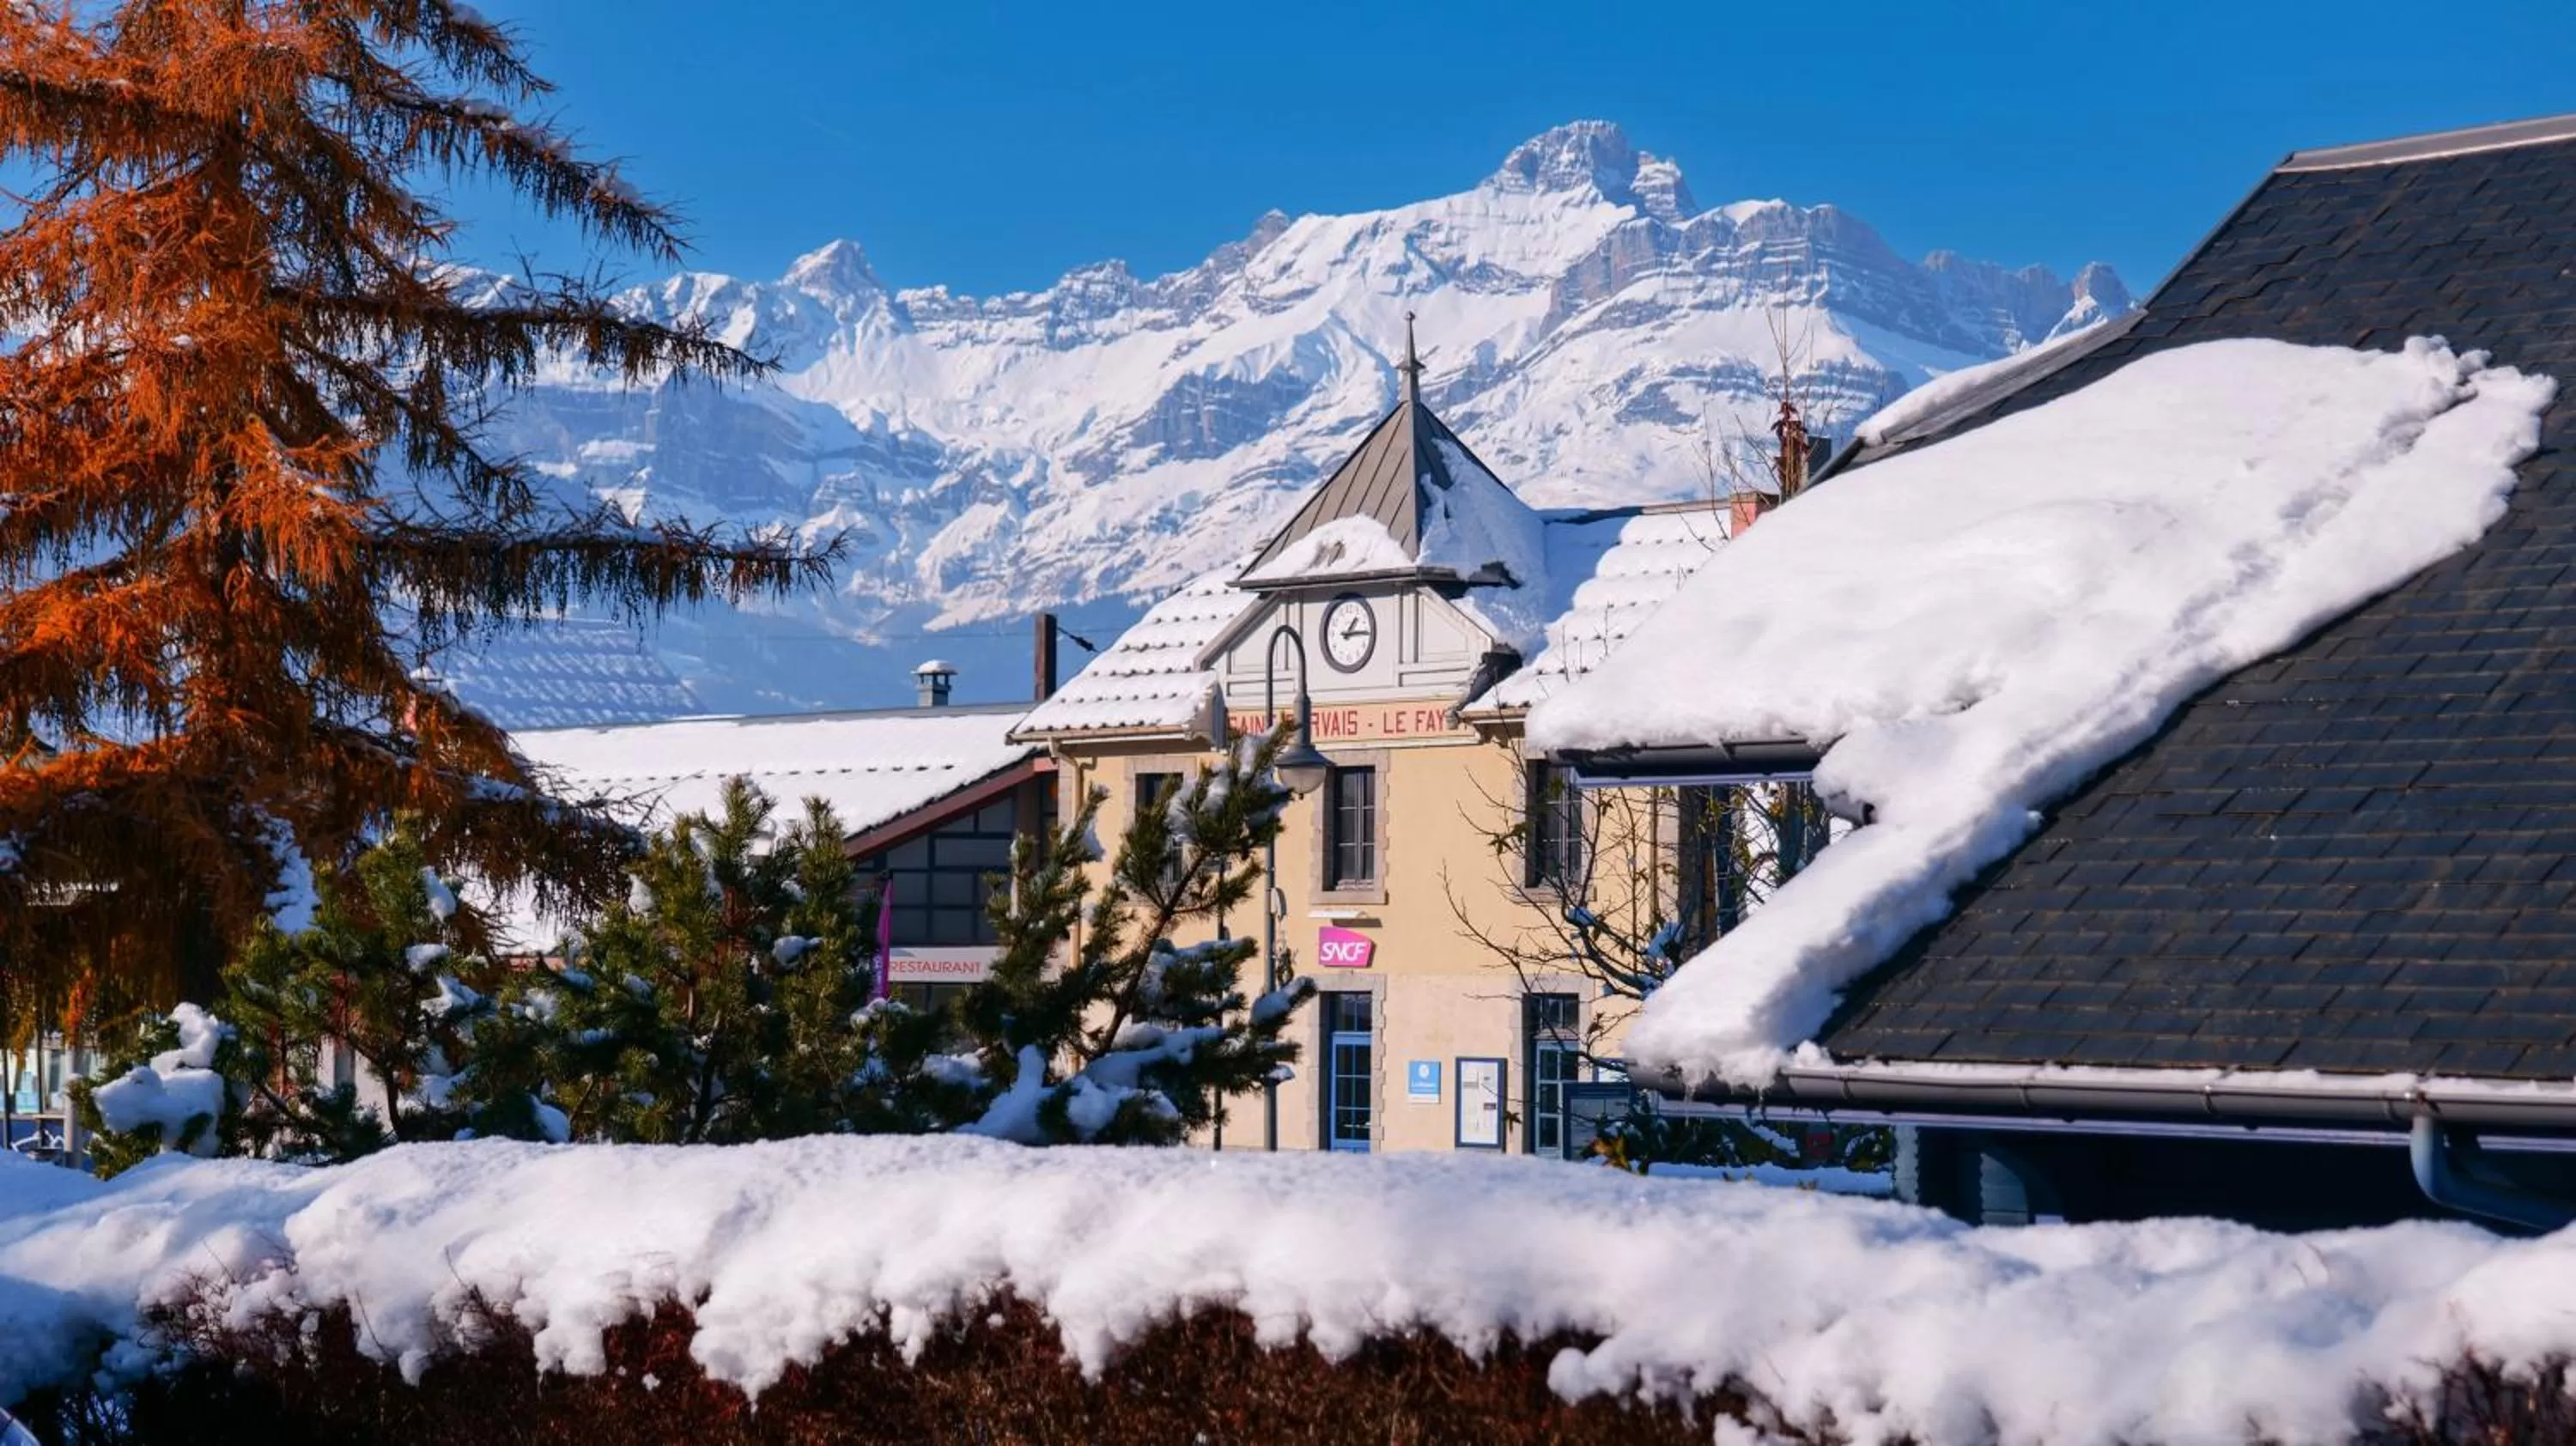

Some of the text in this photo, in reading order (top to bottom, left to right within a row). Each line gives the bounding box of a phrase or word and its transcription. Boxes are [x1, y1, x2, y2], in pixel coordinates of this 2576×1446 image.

[1383, 711, 1406, 734] LE
[1320, 942, 1367, 961] SNCF
[890, 961, 981, 973] RESTAURANT
